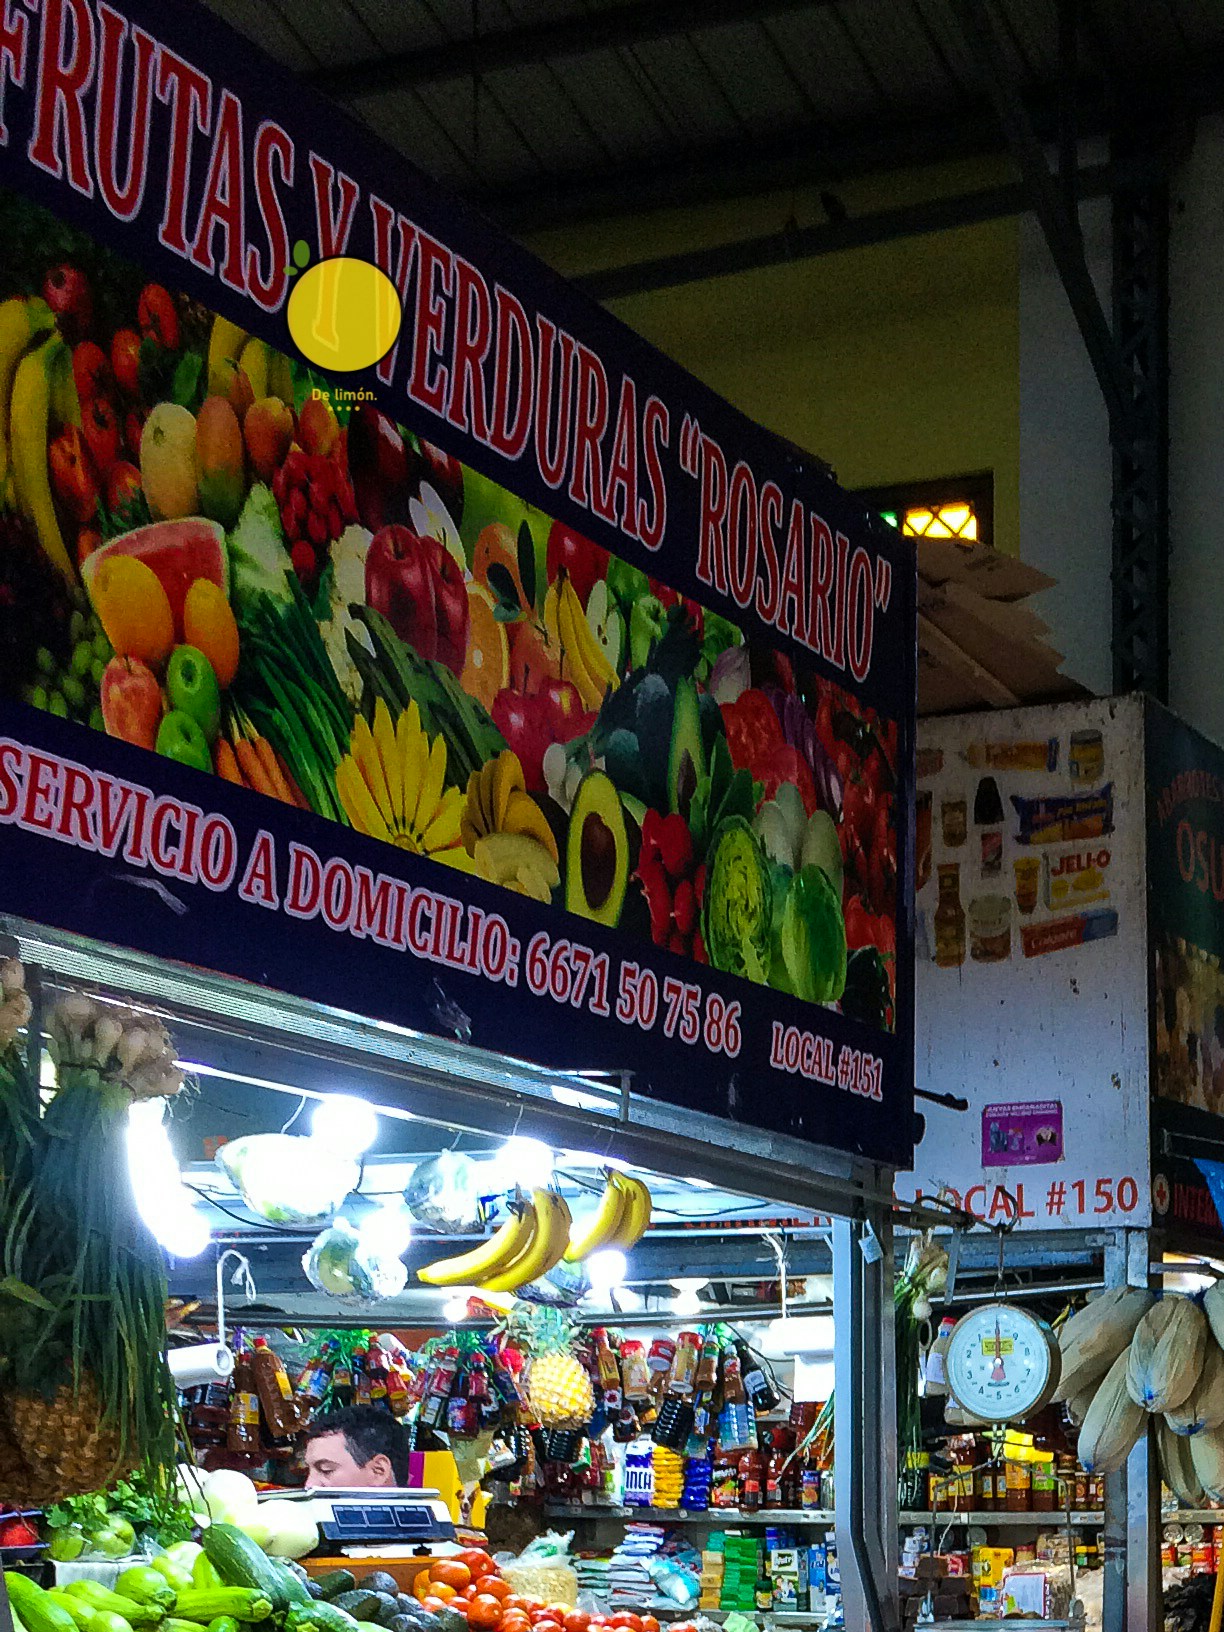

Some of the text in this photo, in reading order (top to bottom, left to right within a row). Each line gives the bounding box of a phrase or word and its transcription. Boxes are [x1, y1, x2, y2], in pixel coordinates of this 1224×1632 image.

[370, 193, 670, 553] VERDURAS
[0, 737, 884, 1101] SERVICIO A DOMICILIO: 6671 50 75 86 LOCAL #151
[1046, 1175, 1139, 1216] #150
